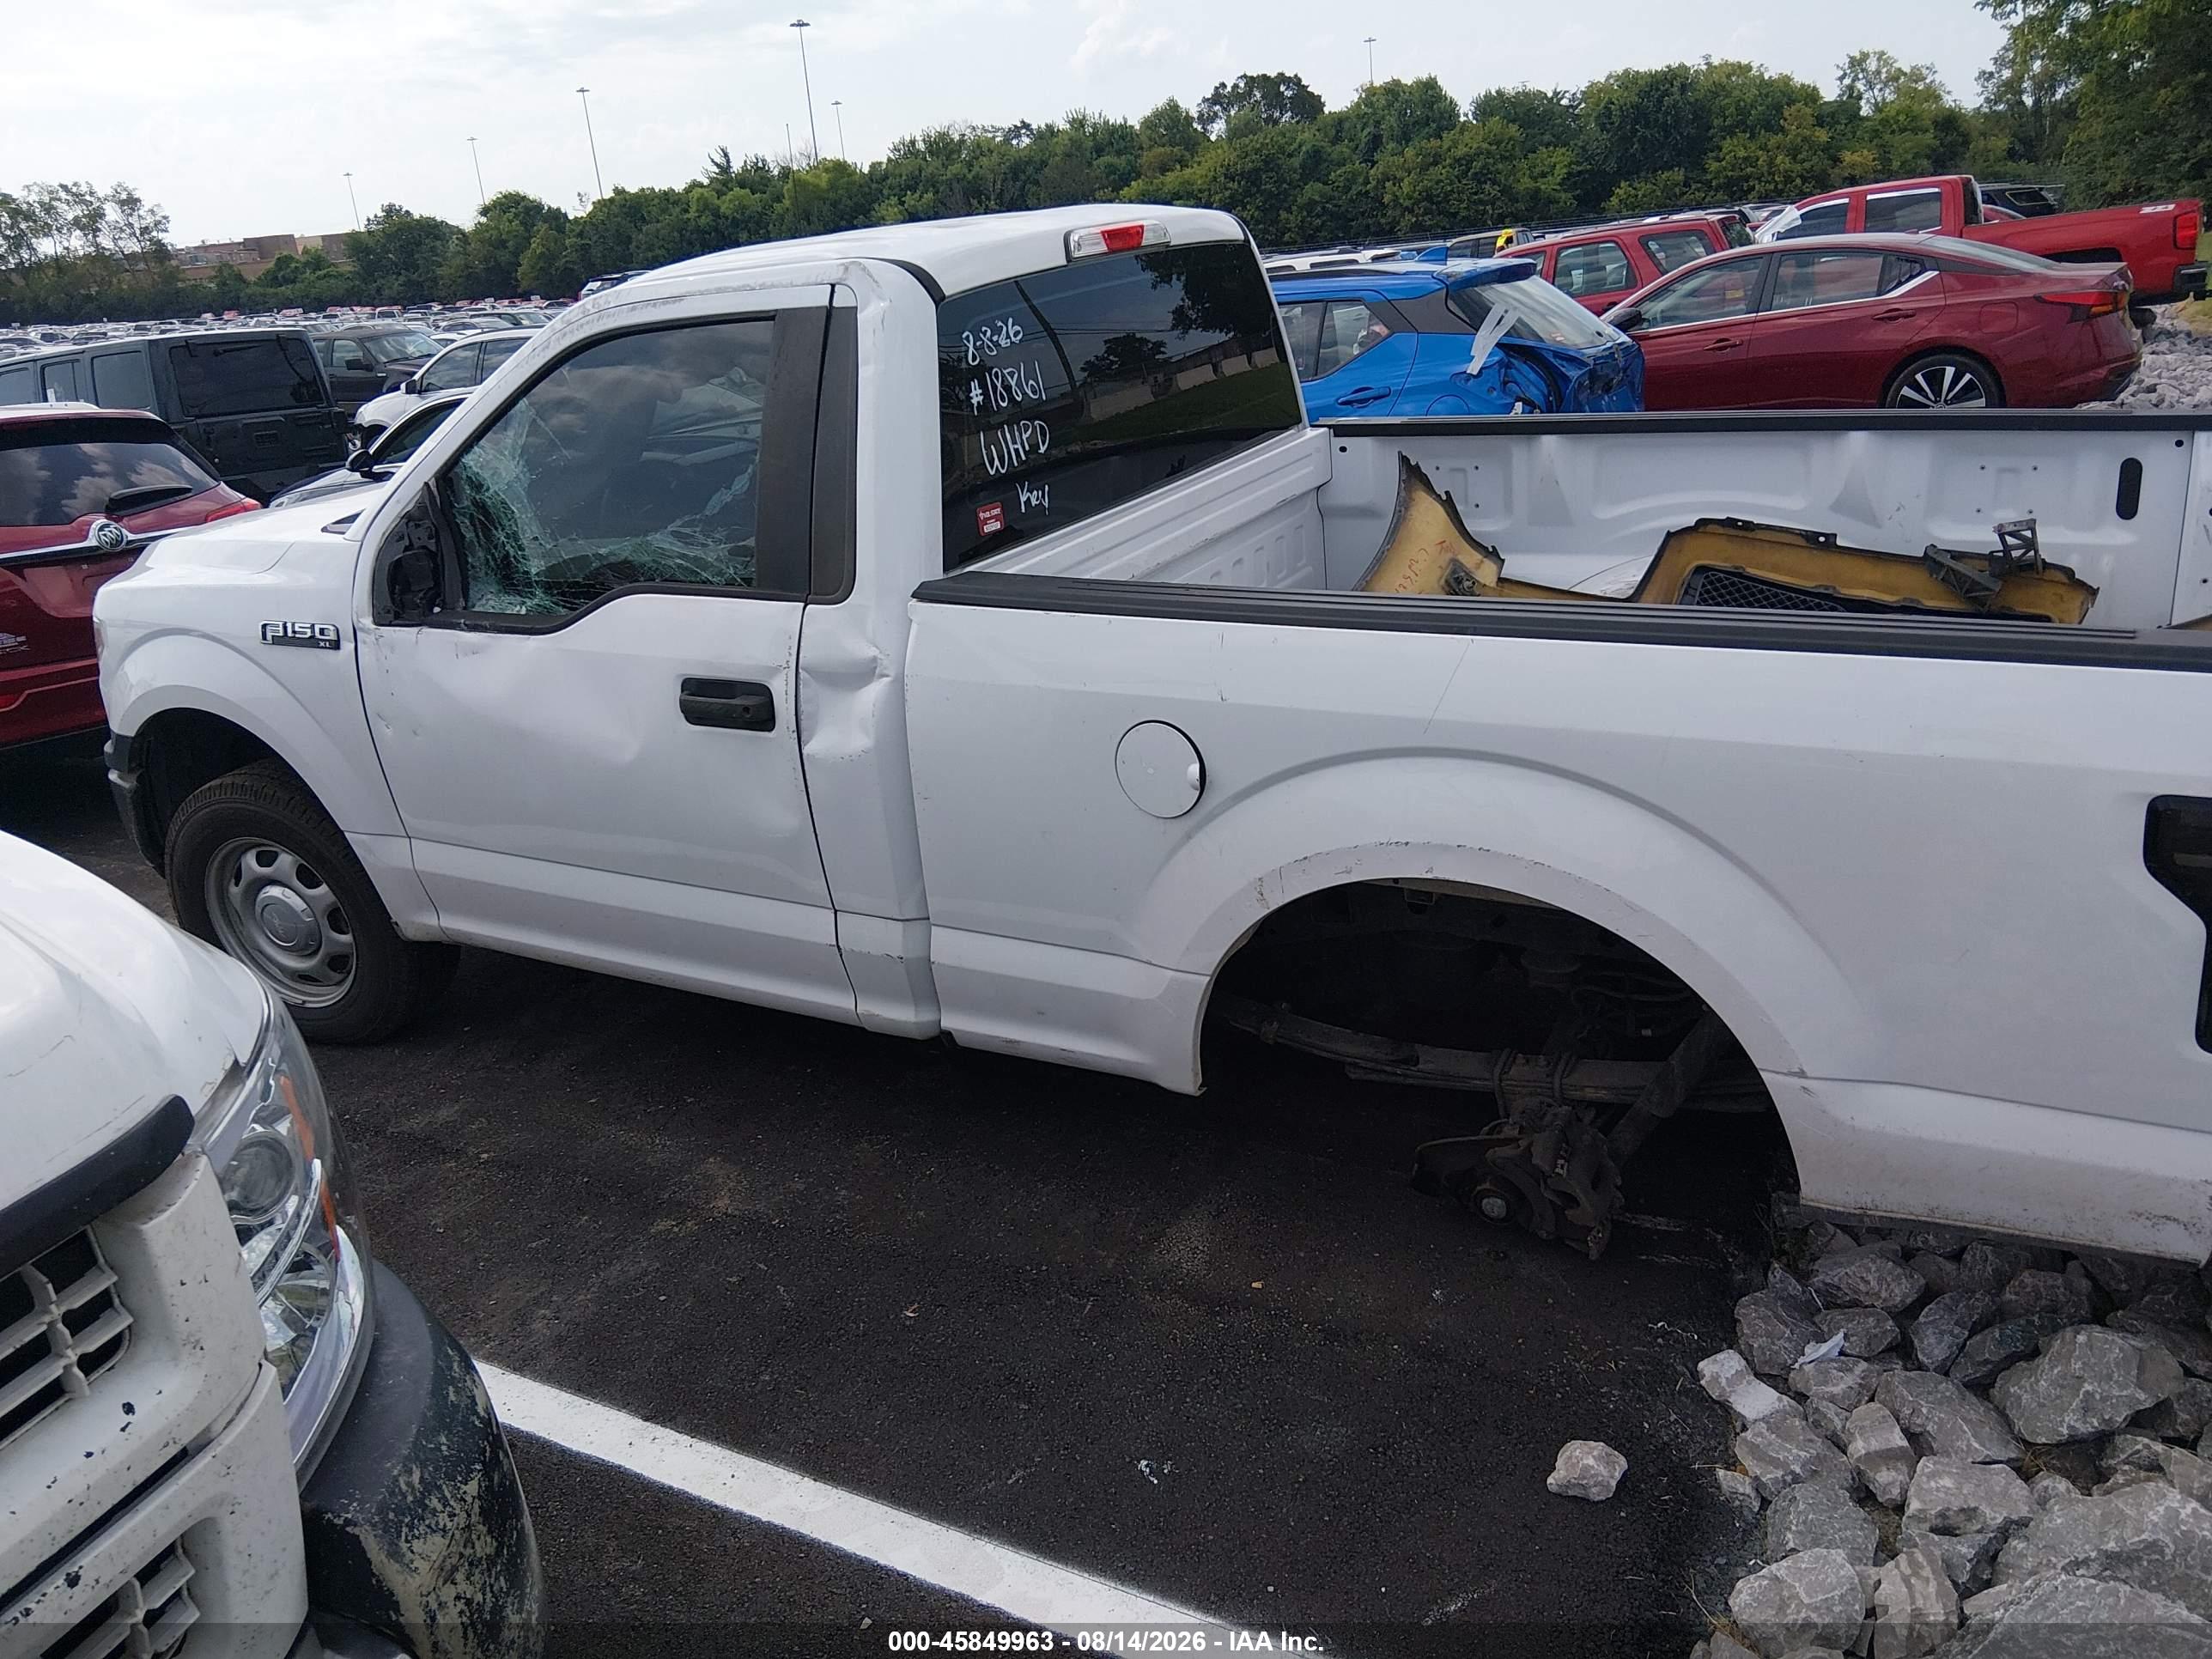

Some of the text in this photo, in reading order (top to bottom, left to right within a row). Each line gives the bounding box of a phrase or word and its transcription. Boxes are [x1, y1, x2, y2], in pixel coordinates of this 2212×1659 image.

[962, 318, 1023, 366] 8-8-26
[969, 360, 1047, 416] #18861
[981, 421, 1050, 476] WHPD
[1016, 483, 1050, 515] Key
[259, 620, 338, 644] F150
